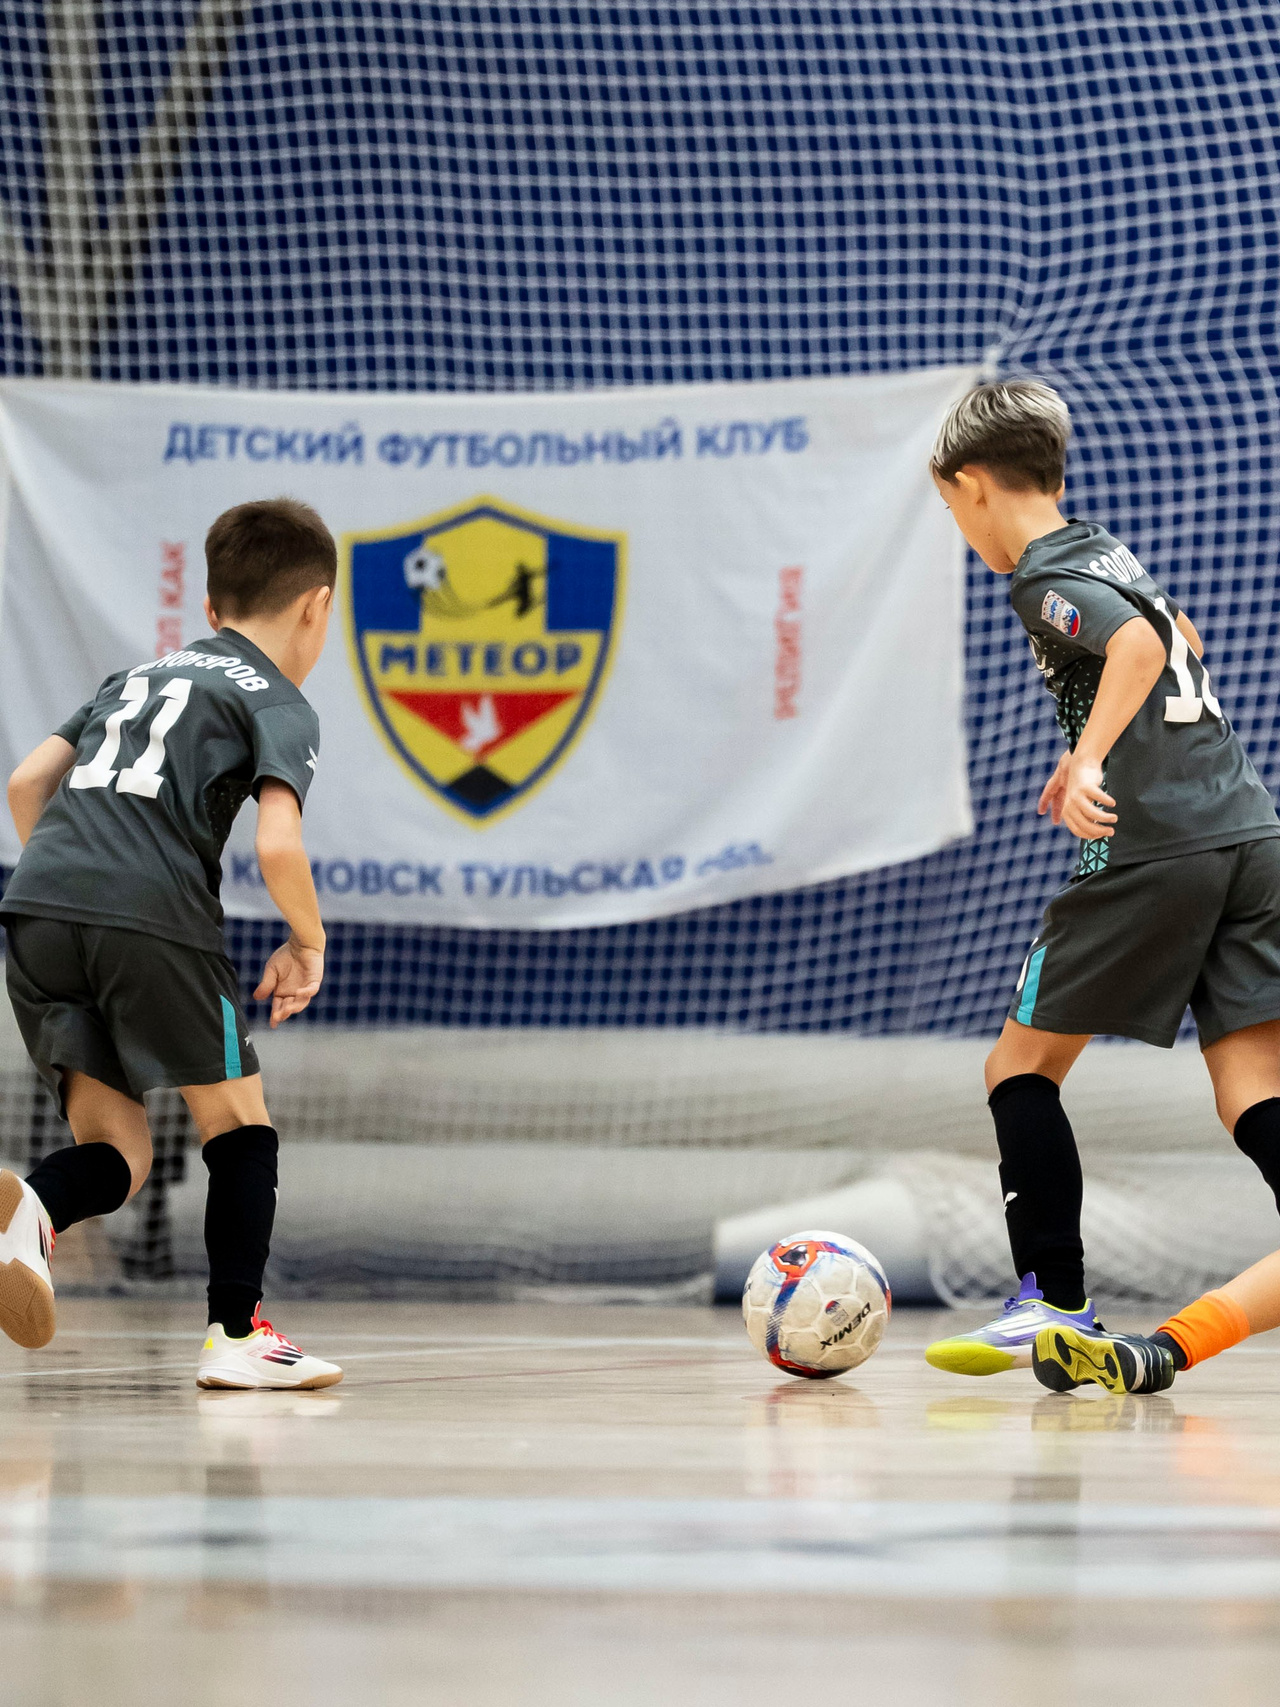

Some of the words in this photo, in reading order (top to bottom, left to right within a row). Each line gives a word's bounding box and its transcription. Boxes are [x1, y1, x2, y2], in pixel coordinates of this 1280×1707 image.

[163, 420, 364, 466] ДЕТСКИЙ
[378, 417, 683, 469] ФУТБОЛЬНЫЙ
[696, 415, 808, 458] КЛУБ
[380, 641, 582, 677] МЕТЕОР
[69, 676, 193, 798] 11
[231, 853, 443, 896] КОВСК
[820, 1302, 871, 1350] DEMIX
